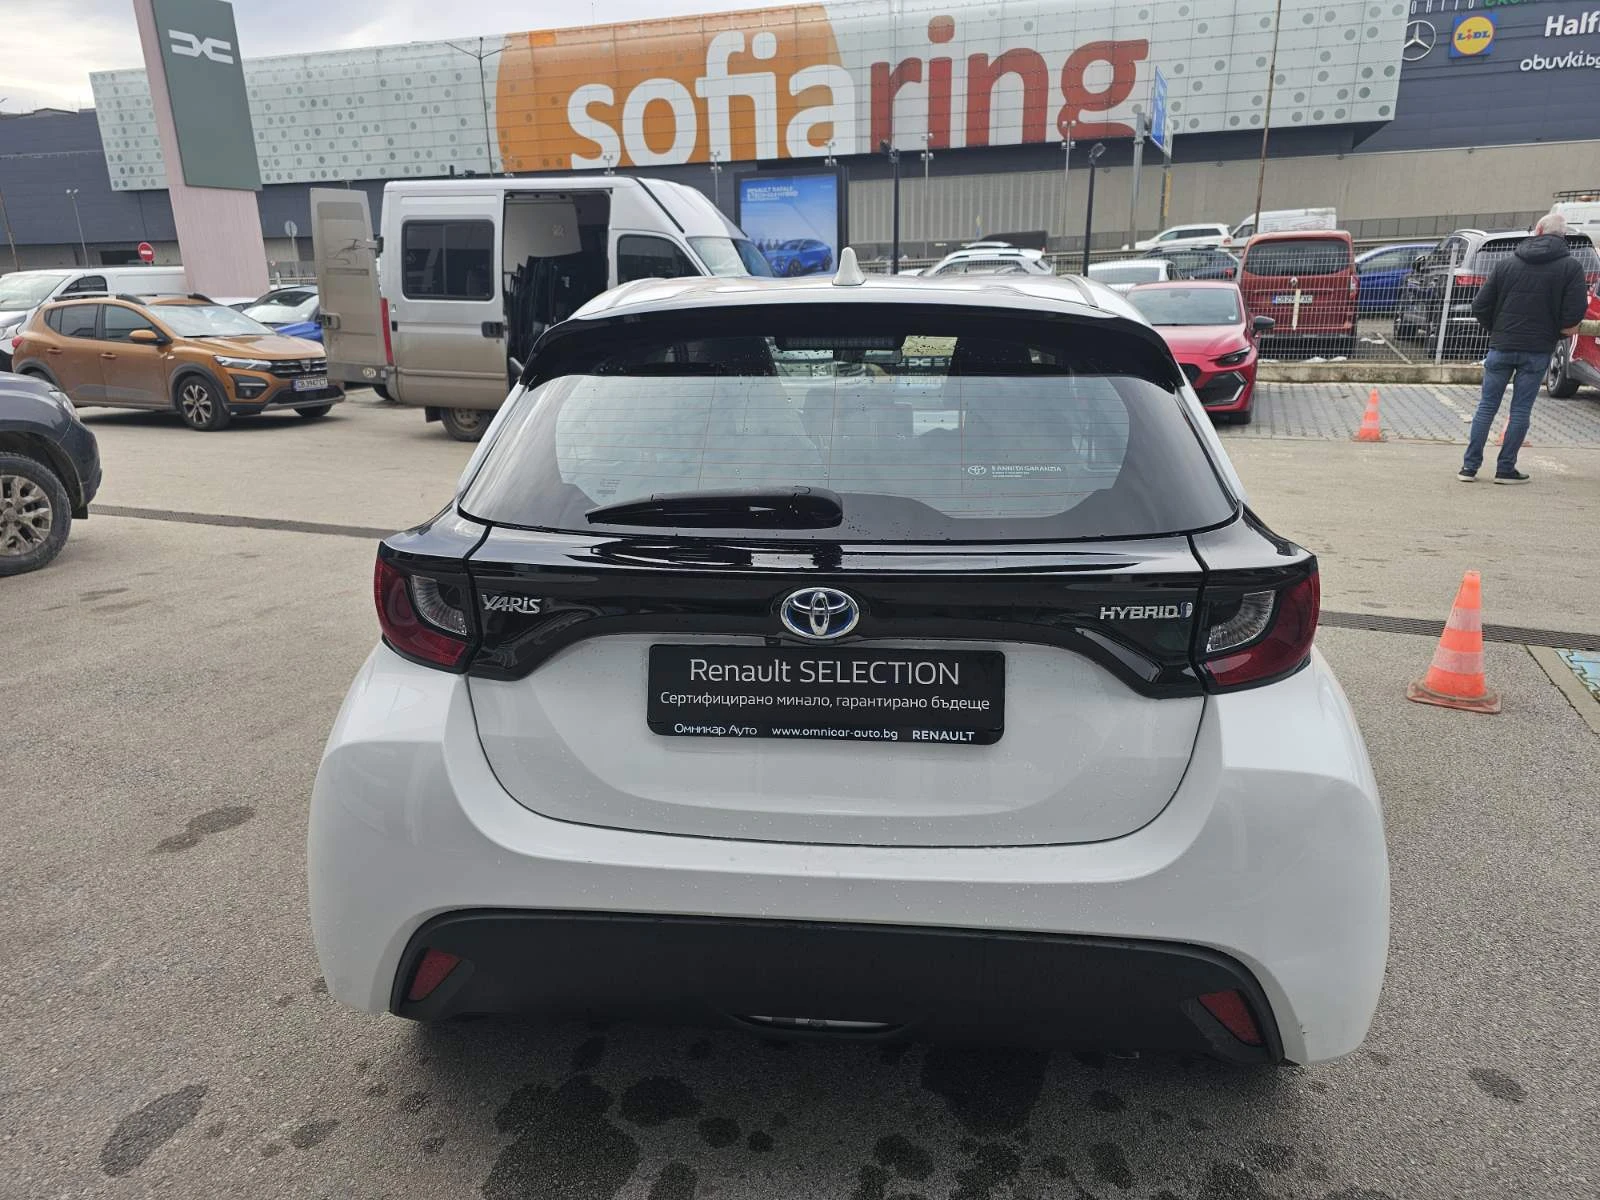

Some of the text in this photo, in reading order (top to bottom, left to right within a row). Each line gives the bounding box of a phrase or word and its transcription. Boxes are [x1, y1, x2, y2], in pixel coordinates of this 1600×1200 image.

[1544, 10, 1600, 37] Half
[1100, 605, 1179, 620] HYBRID
[689, 658, 959, 685] Renault SELECTION
[660, 691, 990, 711] Сертифицирано минало, гарантирано бъдеще
[674, 723, 758, 736] Омникар Ауто
[771, 726, 898, 741] www.omnicar-auto.bg
[912, 729, 975, 741] RENAULT
